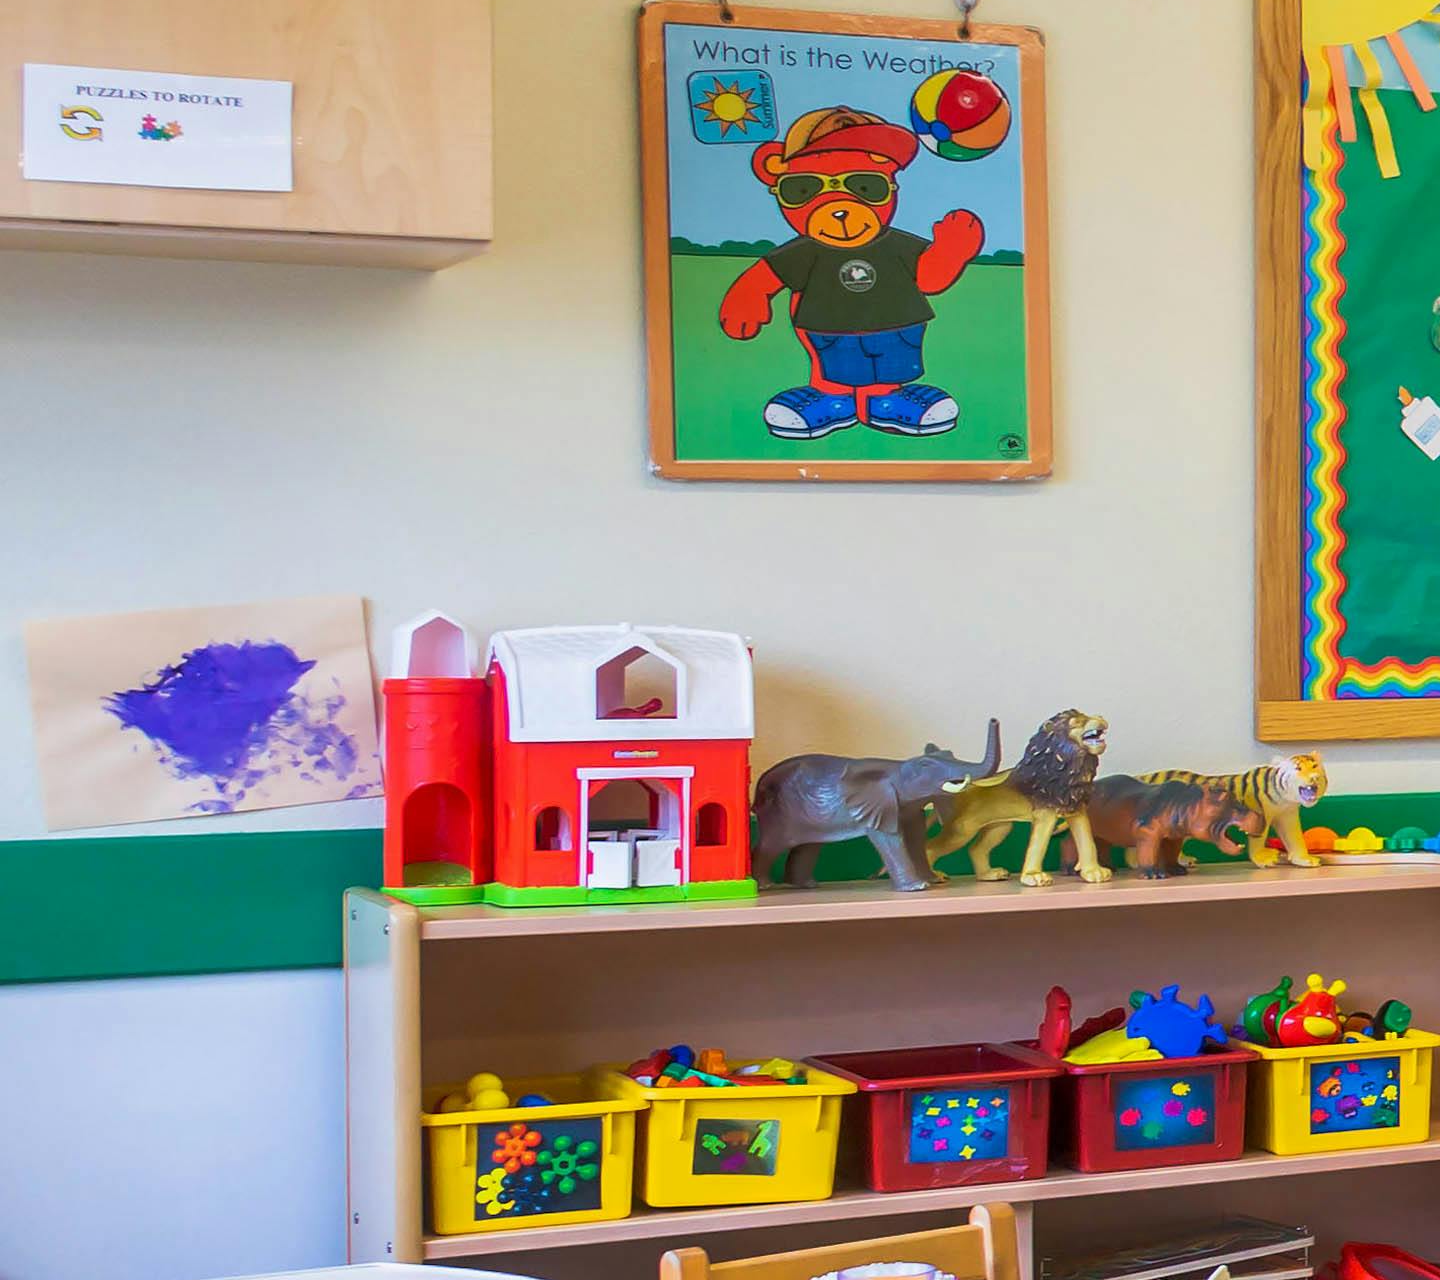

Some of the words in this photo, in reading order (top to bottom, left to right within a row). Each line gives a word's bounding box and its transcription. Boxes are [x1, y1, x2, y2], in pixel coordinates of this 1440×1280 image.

[693, 40, 769, 64] What
[780, 45, 797, 66] is
[806, 47, 853, 70] the
[75, 85, 149, 102] PUZZLES
[151, 91, 175, 104] TO
[178, 93, 244, 108] ROTATE
[760, 81, 776, 129] Summer
